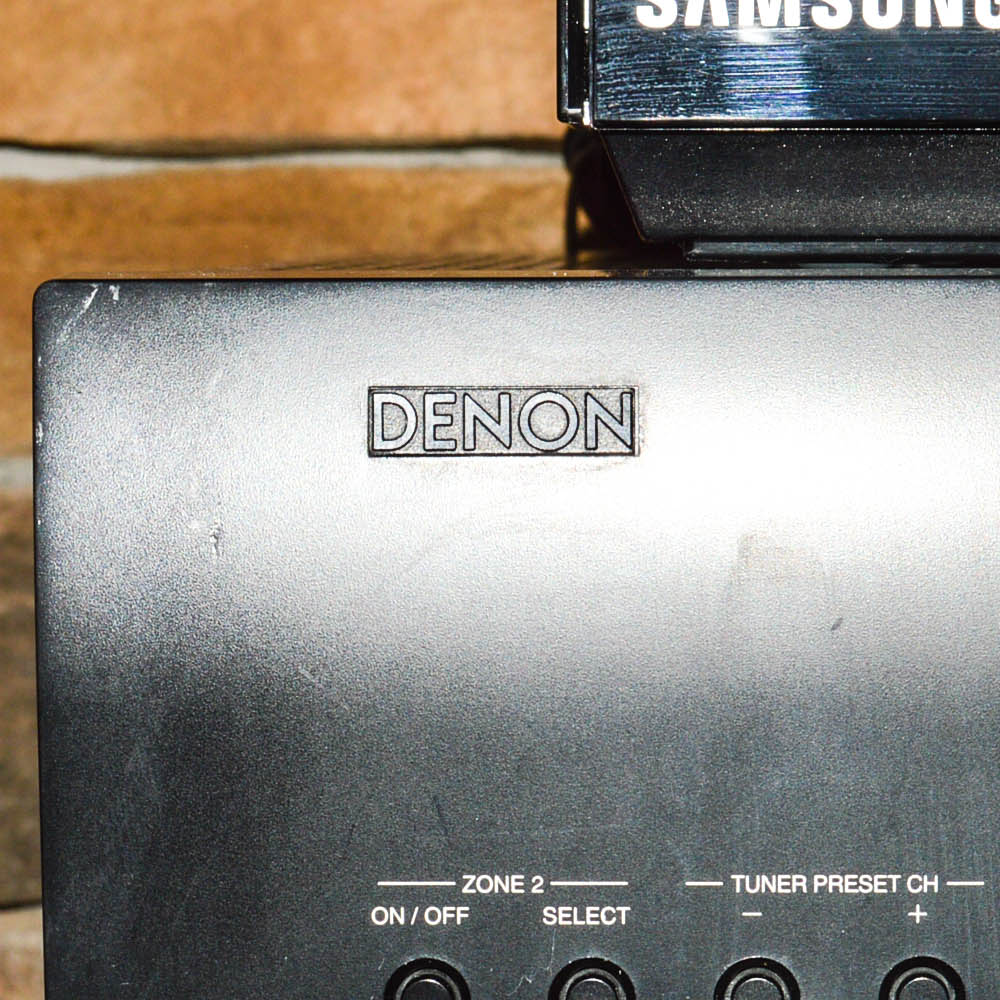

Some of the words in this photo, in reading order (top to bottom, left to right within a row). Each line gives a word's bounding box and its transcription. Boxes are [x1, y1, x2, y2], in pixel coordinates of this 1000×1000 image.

[370, 390, 635, 453] DENON
[461, 874, 526, 895] ZONE
[530, 874, 545, 895] 2
[730, 874, 808, 895] TUNER
[812, 873, 902, 895] PRESET
[905, 873, 939, 895] CH
[370, 905, 406, 926] ON
[423, 905, 470, 926] OFF
[542, 905, 632, 927] SELECT
